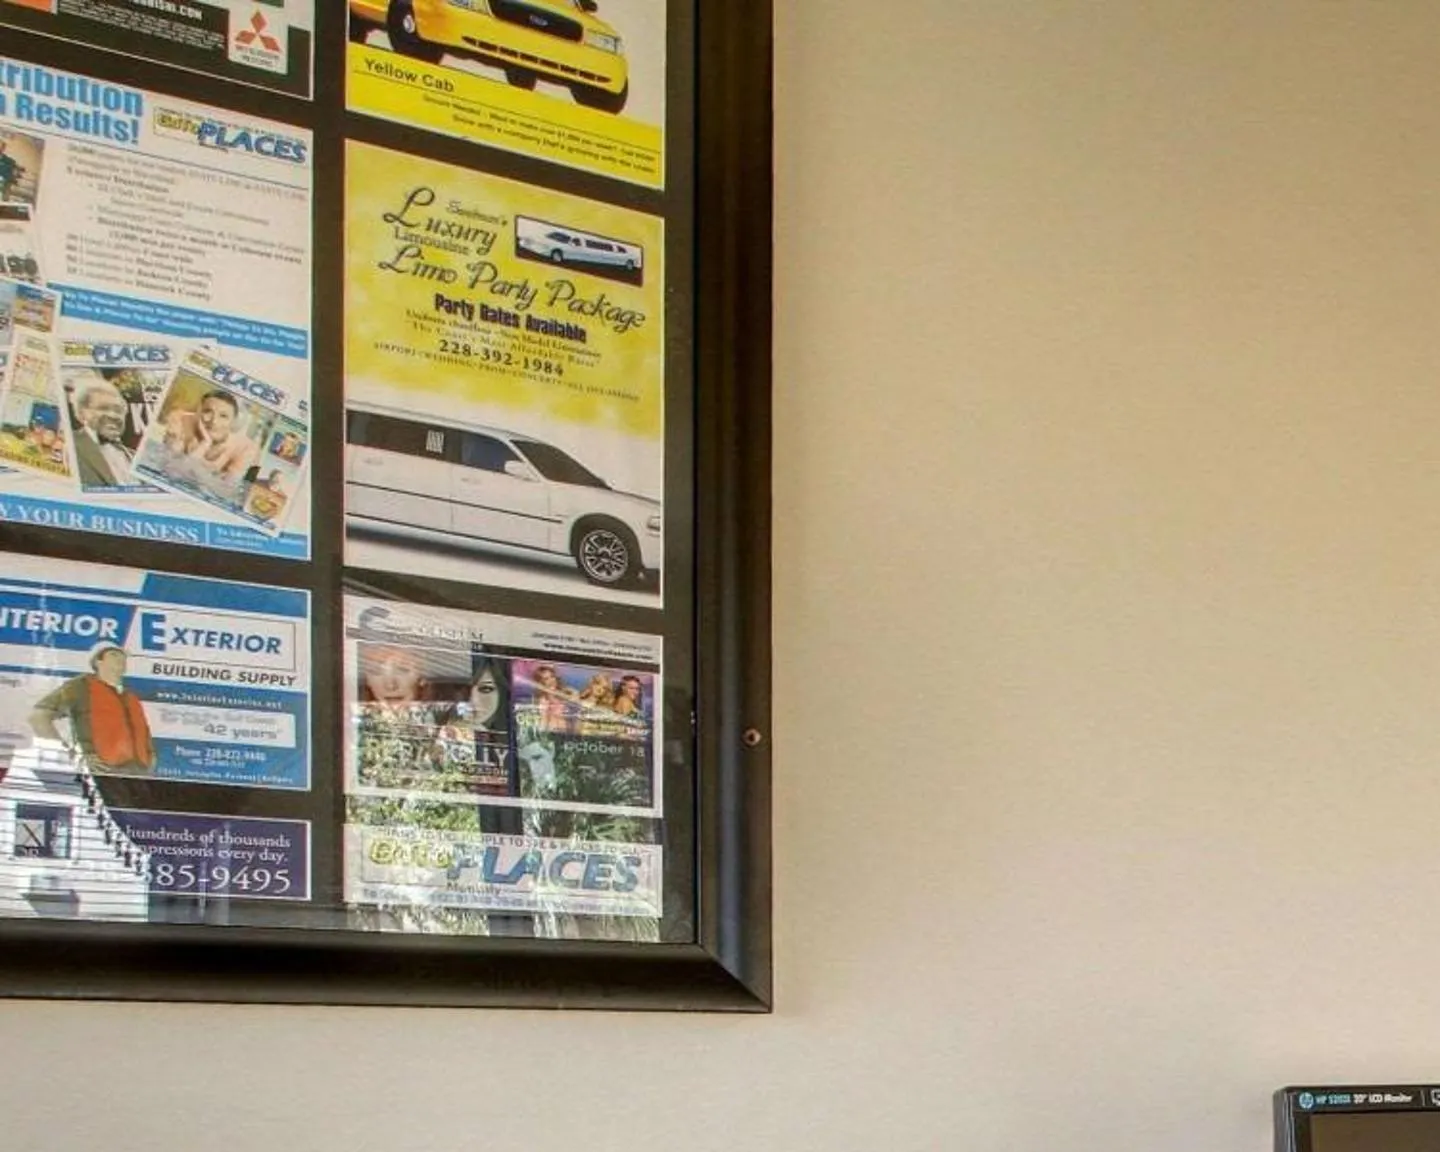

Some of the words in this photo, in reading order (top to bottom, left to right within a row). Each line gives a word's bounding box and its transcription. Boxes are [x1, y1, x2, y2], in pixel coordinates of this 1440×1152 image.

[364, 57, 417, 83] Yellow
[422, 74, 455, 93] Cab
[15, 92, 139, 145] Results!
[198, 121, 308, 164] PLACES
[383, 187, 498, 256] Luxury
[378, 244, 458, 285] Limo
[466, 261, 538, 311] Party
[544, 279, 646, 333] Package
[434, 292, 474, 321] Party
[479, 303, 520, 328] Rates
[525, 314, 587, 344] Available
[93, 344, 171, 365] PLACES
[439, 339, 564, 377] 228-392-1984
[212, 364, 285, 406] PLACES
[18, 504, 84, 529] YOUR
[91, 514, 200, 544] BUSINESS
[141, 612, 283, 654] EXTERIOR
[152, 663, 232, 681] BUILDING
[237, 671, 297, 687] SUPPLY
[203, 723, 228, 736] 42
[127, 824, 195, 843] hundreds
[200, 829, 215, 848] of
[219, 831, 291, 848] thousands
[217, 849, 256, 863] every
[259, 848, 289, 864] day.
[447, 843, 642, 892] PLACES
